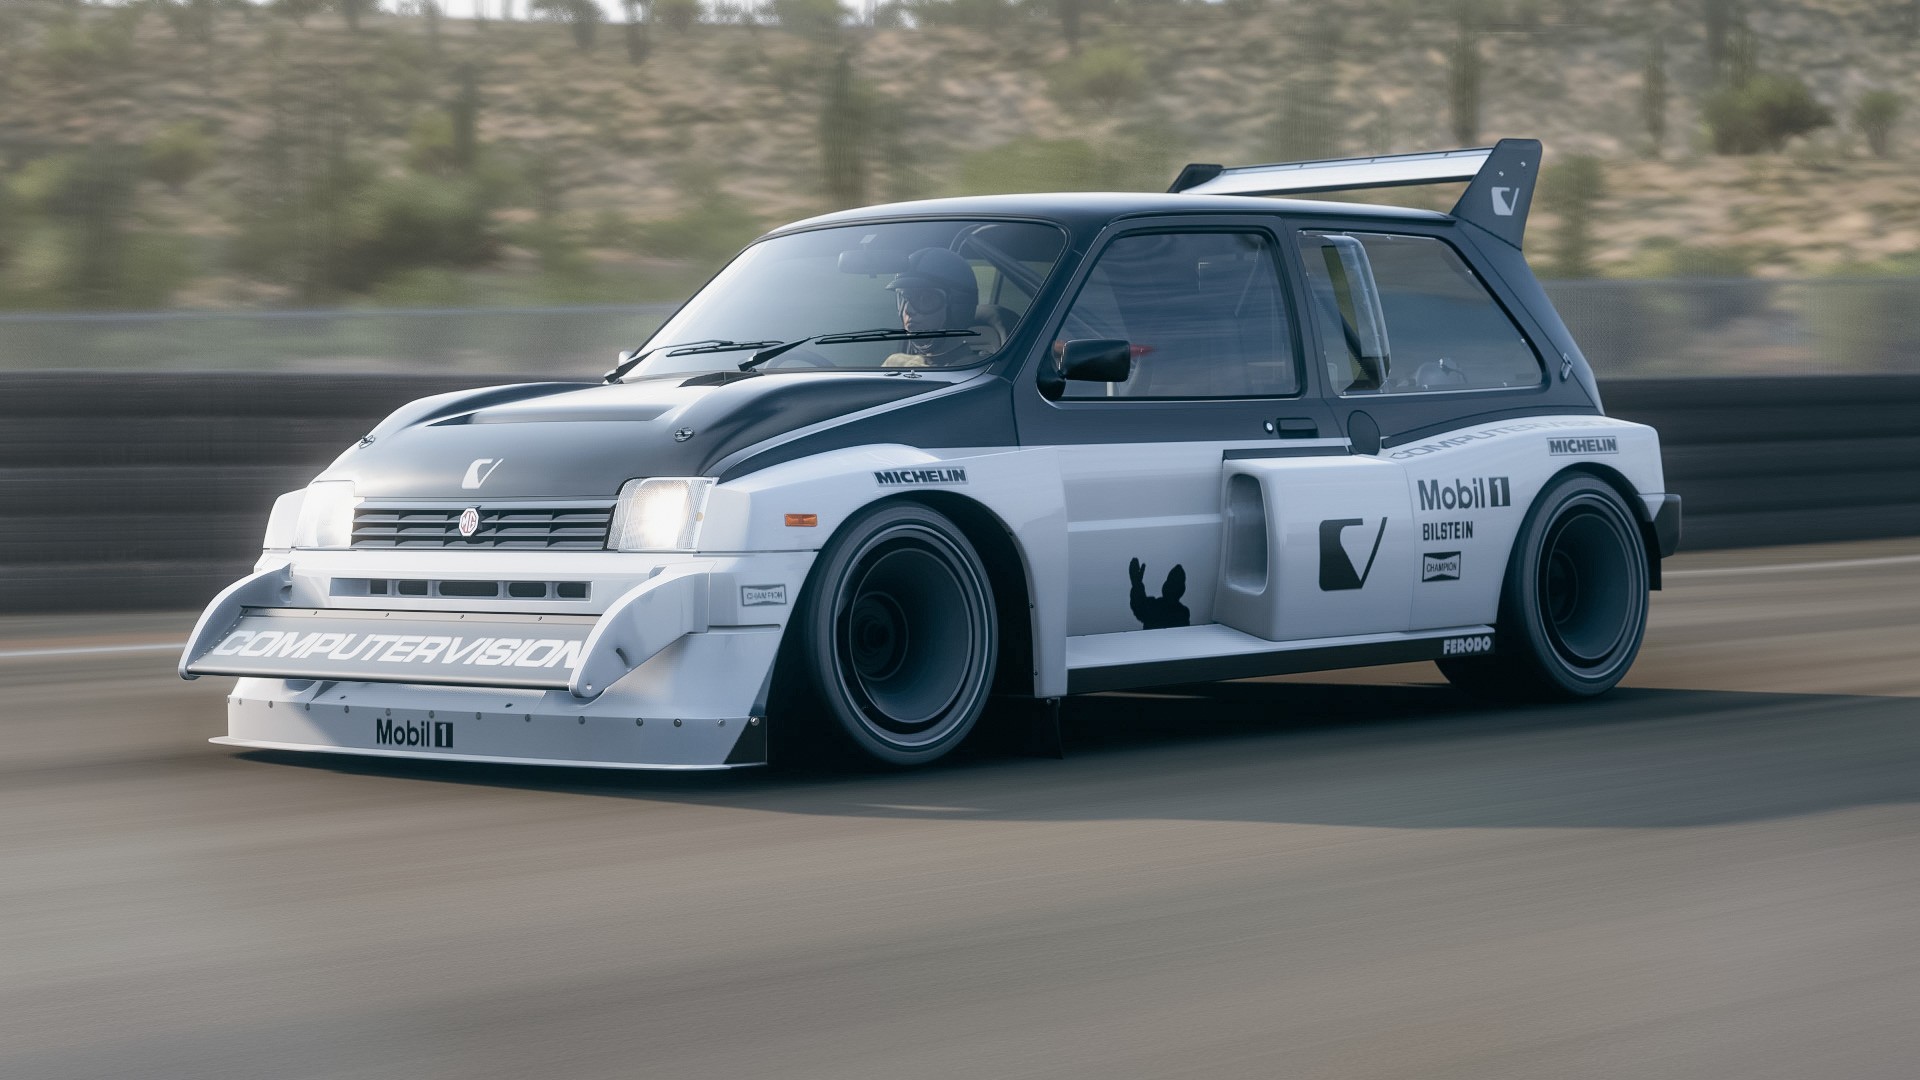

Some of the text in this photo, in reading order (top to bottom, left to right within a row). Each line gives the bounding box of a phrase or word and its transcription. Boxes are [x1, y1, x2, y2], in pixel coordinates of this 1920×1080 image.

[1550, 438, 1617, 453] MICHELIN
[873, 469, 967, 484] MICHELIN
[1417, 478, 1506, 511] Mobil 1
[461, 509, 477, 534] MG
[1423, 521, 1473, 541] BILSTEIN
[1426, 562, 1457, 573] CHAMPION
[212, 630, 582, 669] COMPUTERVISION
[1443, 635, 1492, 655] FERODO
[376, 718, 430, 748] Mobil
